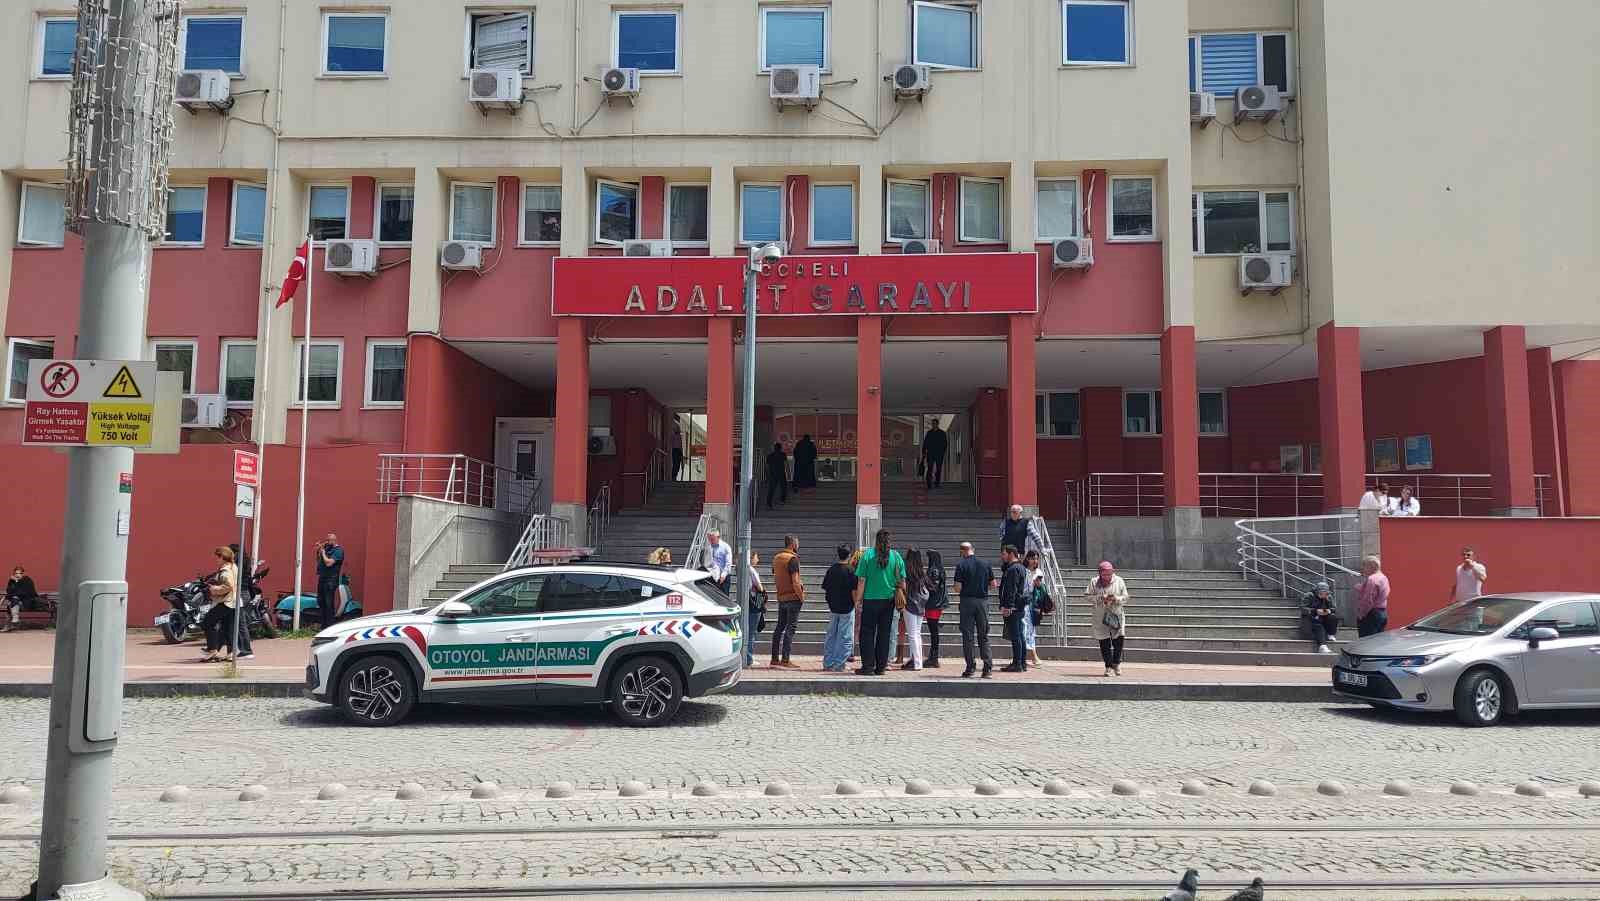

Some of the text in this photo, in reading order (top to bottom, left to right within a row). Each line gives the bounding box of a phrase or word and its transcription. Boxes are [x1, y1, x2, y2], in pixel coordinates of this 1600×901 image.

[811, 280, 971, 311] SARAYI
[36, 407, 50, 416] Ray
[28, 417, 54, 425] Girmek
[91, 411, 151, 423] Yüksek Voltaj
[100, 422, 115, 430] High
[100, 431, 138, 441] 750 Volt
[668, 596, 681, 604] 112
[431, 647, 590, 664] OTOYOL JANDARMASI
[444, 667, 524, 676] www.jandarma.gov.tr
